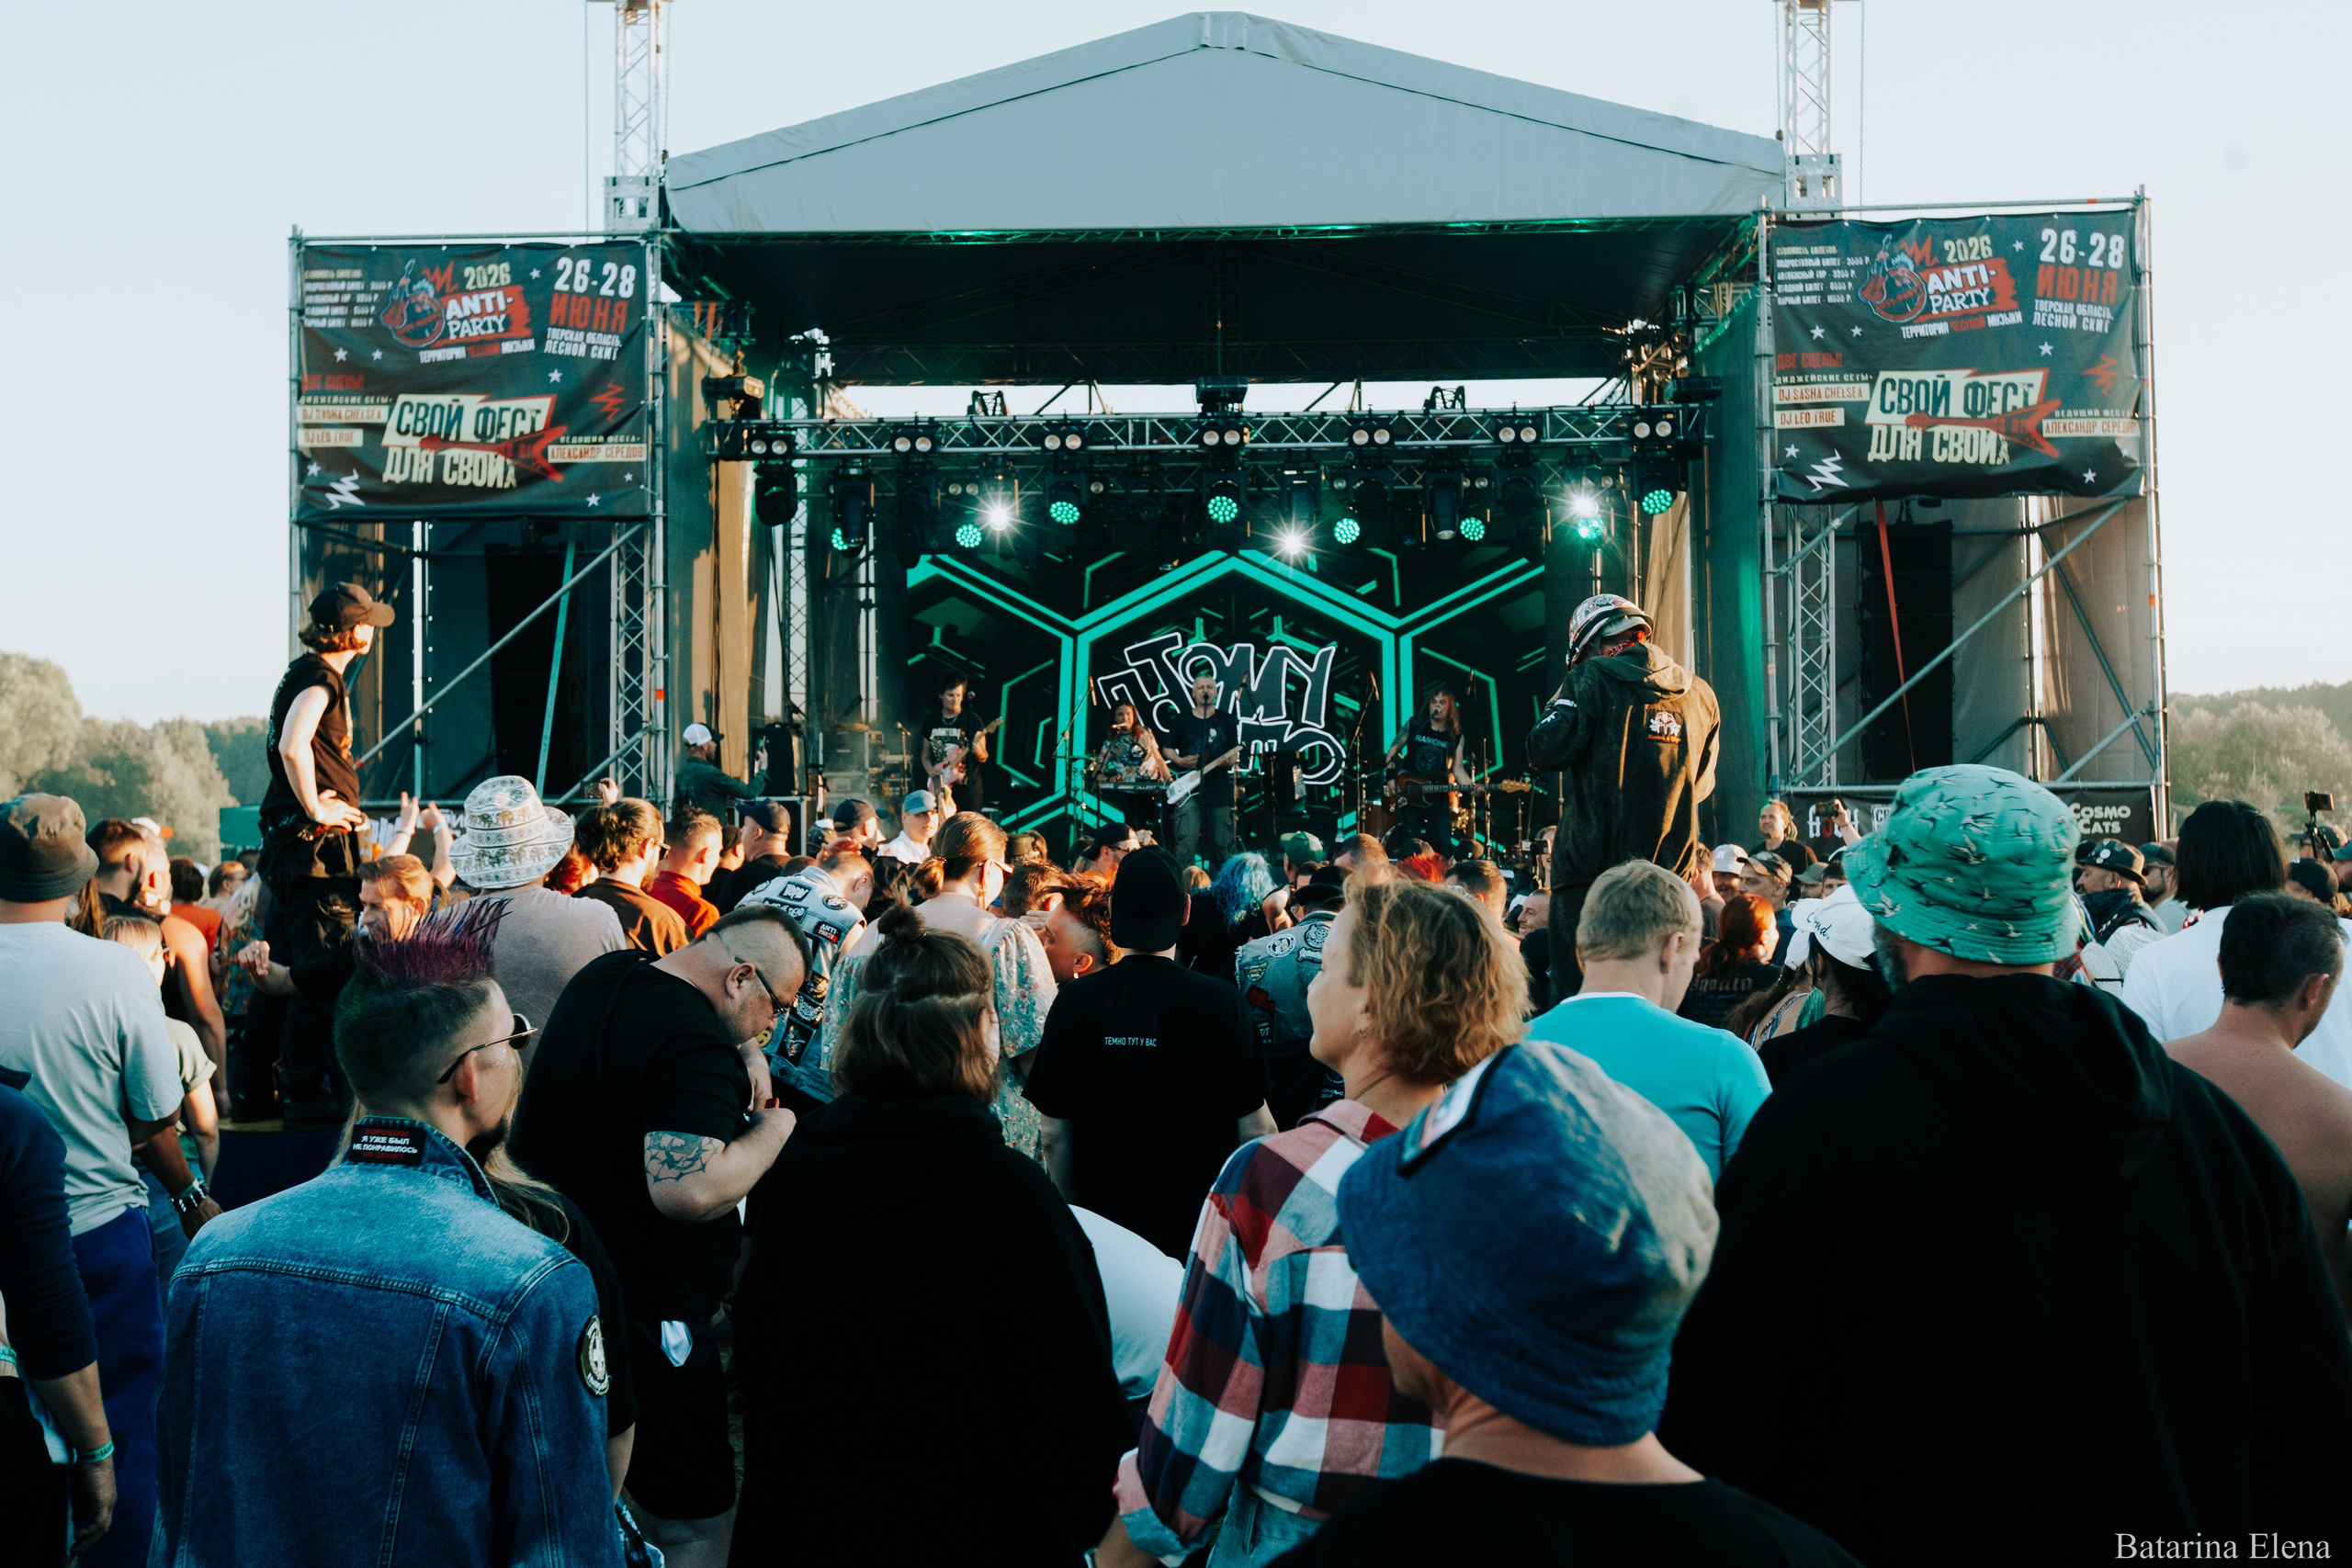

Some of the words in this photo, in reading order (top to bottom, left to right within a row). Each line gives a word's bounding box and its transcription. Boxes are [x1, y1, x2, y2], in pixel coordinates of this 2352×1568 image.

[1944, 234, 1993, 265] 2026
[2040, 228, 2125, 269] 26-28
[463, 262, 511, 290] 2026
[554, 256, 636, 299] 26-28
[1928, 263, 1997, 295] ANTI-
[2037, 264, 2118, 304] ИЮНЯ
[446, 289, 514, 321] ANTI-
[549, 292, 628, 333] ИЮНЯ
[1929, 288, 1990, 314] PARTY
[2034, 299, 2075, 315] ТВЕРСКАЯ
[447, 314, 506, 340] PARTY
[1901, 321, 1950, 339] ТЕРРИТОРИЯ
[1987, 310, 2023, 327] МУЗЫКИ
[2032, 311, 2076, 330] ЛЕСНОЙ
[2082, 317, 2109, 333] СКИТ
[543, 339, 587, 357] ЛЕСНОЙ
[590, 344, 618, 361] СКИТ
[1779, 389, 1791, 401] DJ
[1792, 386, 1822, 400] SASHA
[1825, 386, 1863, 399] CHELSEA
[1880, 374, 1951, 417] СВОЙ
[1963, 380, 2034, 419] ФЕСТ
[396, 399, 464, 441] СВОЙ
[473, 406, 541, 443] ФЕСТ
[1781, 412, 1792, 425] DJ
[1794, 412, 1811, 424] LEO
[1814, 411, 1836, 423] TRUE
[2044, 421, 2098, 434] АЛЕКСАНДР
[550, 446, 602, 459] АЛЕКСАНДР
[1868, 424, 1923, 462] ДЛЯ
[1932, 429, 2010, 465] СВОИХ
[382, 446, 434, 484] ДЛЯ
[443, 451, 517, 489] СВОИХ
[1416, 734, 1448, 749] RAMONE
[1104, 1036, 1126, 1046] ТЕМНО
[1127, 1036, 1139, 1046] ТУТ
[1140, 1037, 1145, 1046] У
[1146, 1037, 1158, 1047] ВАС
[365, 1128, 409, 1137] ХОРОШИМ
[368, 1135, 387, 1144] УЖЕ
[388, 1137, 410, 1145] БЫЛ
[363, 1145, 418, 1154] ПОНРАВИЛОСЬ
